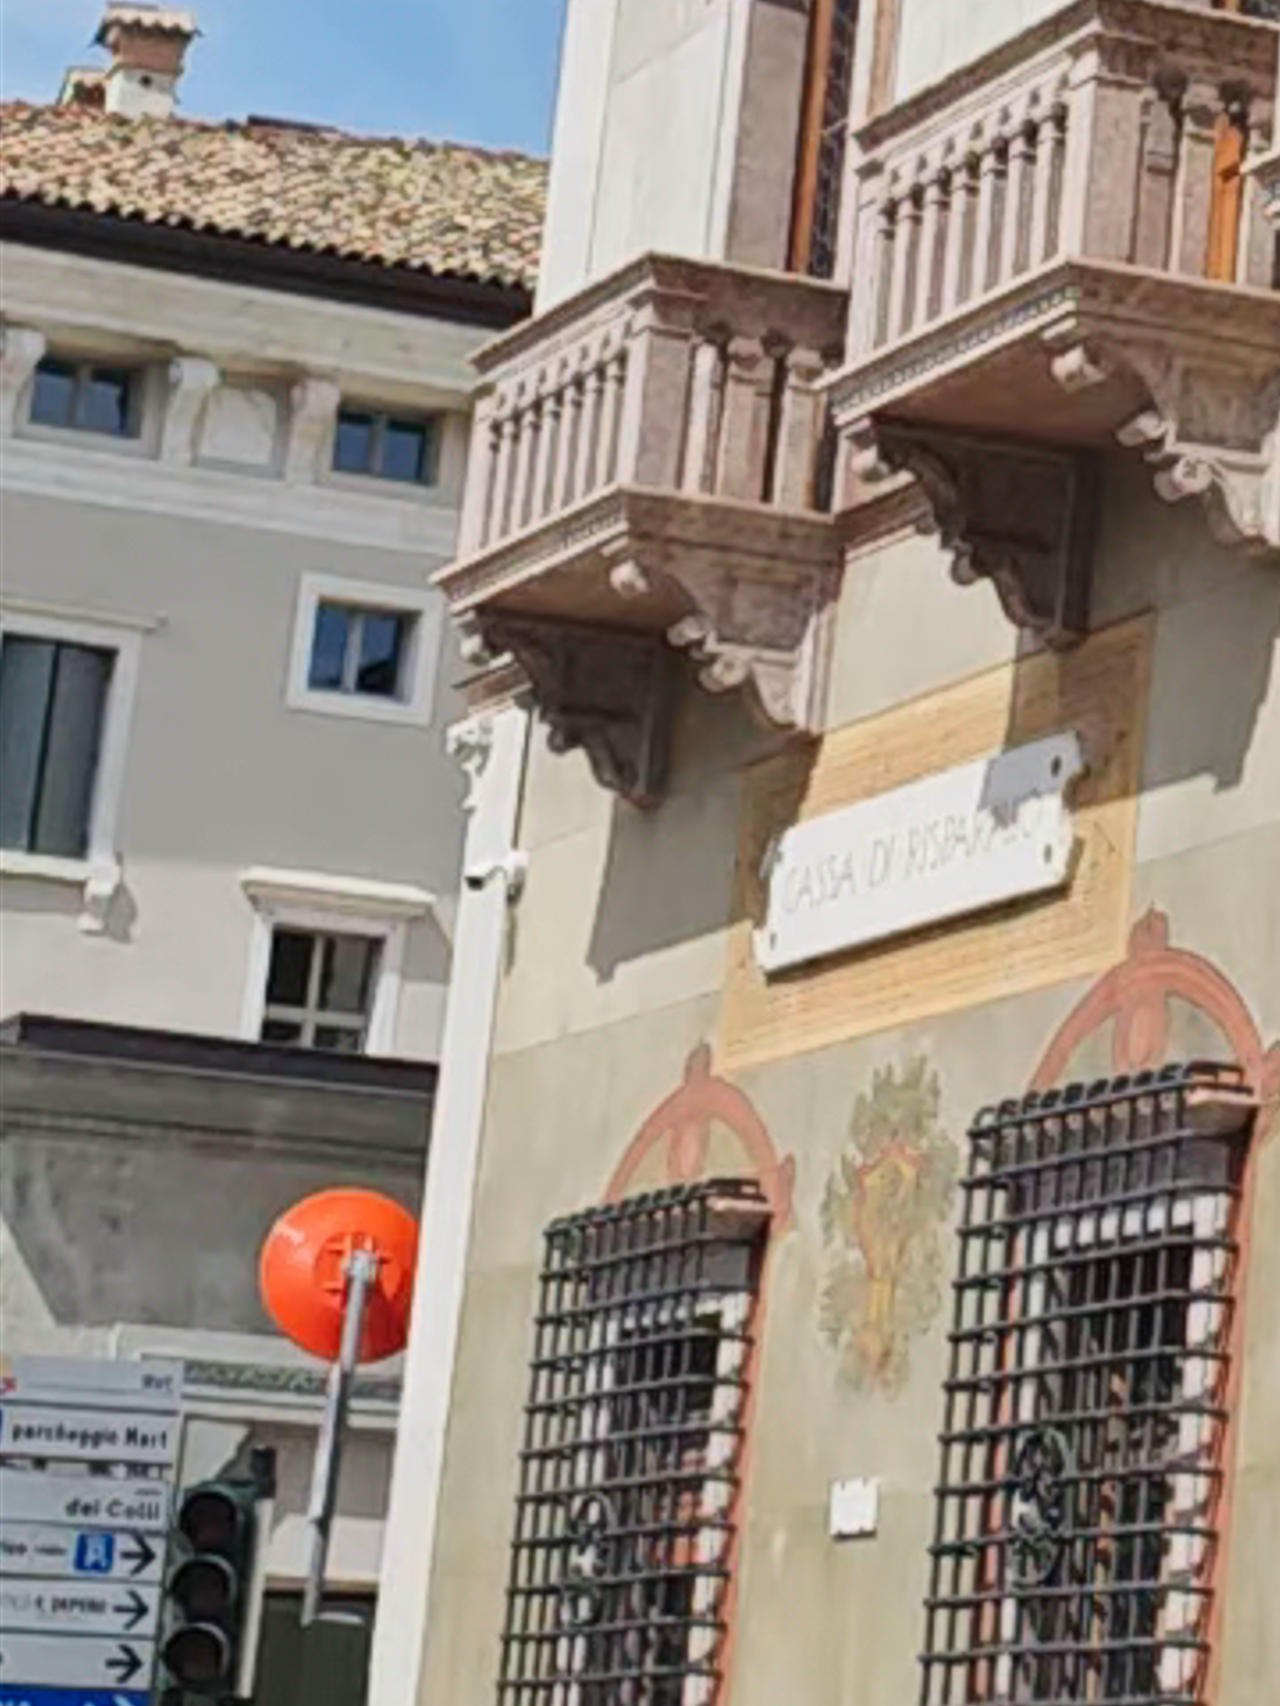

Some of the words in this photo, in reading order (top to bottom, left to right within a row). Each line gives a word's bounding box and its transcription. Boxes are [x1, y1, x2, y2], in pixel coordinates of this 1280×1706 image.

[12, 1422, 118, 1450] parcheggio
[126, 1424, 169, 1450] Mart
[106, 1497, 161, 1521] Colli
